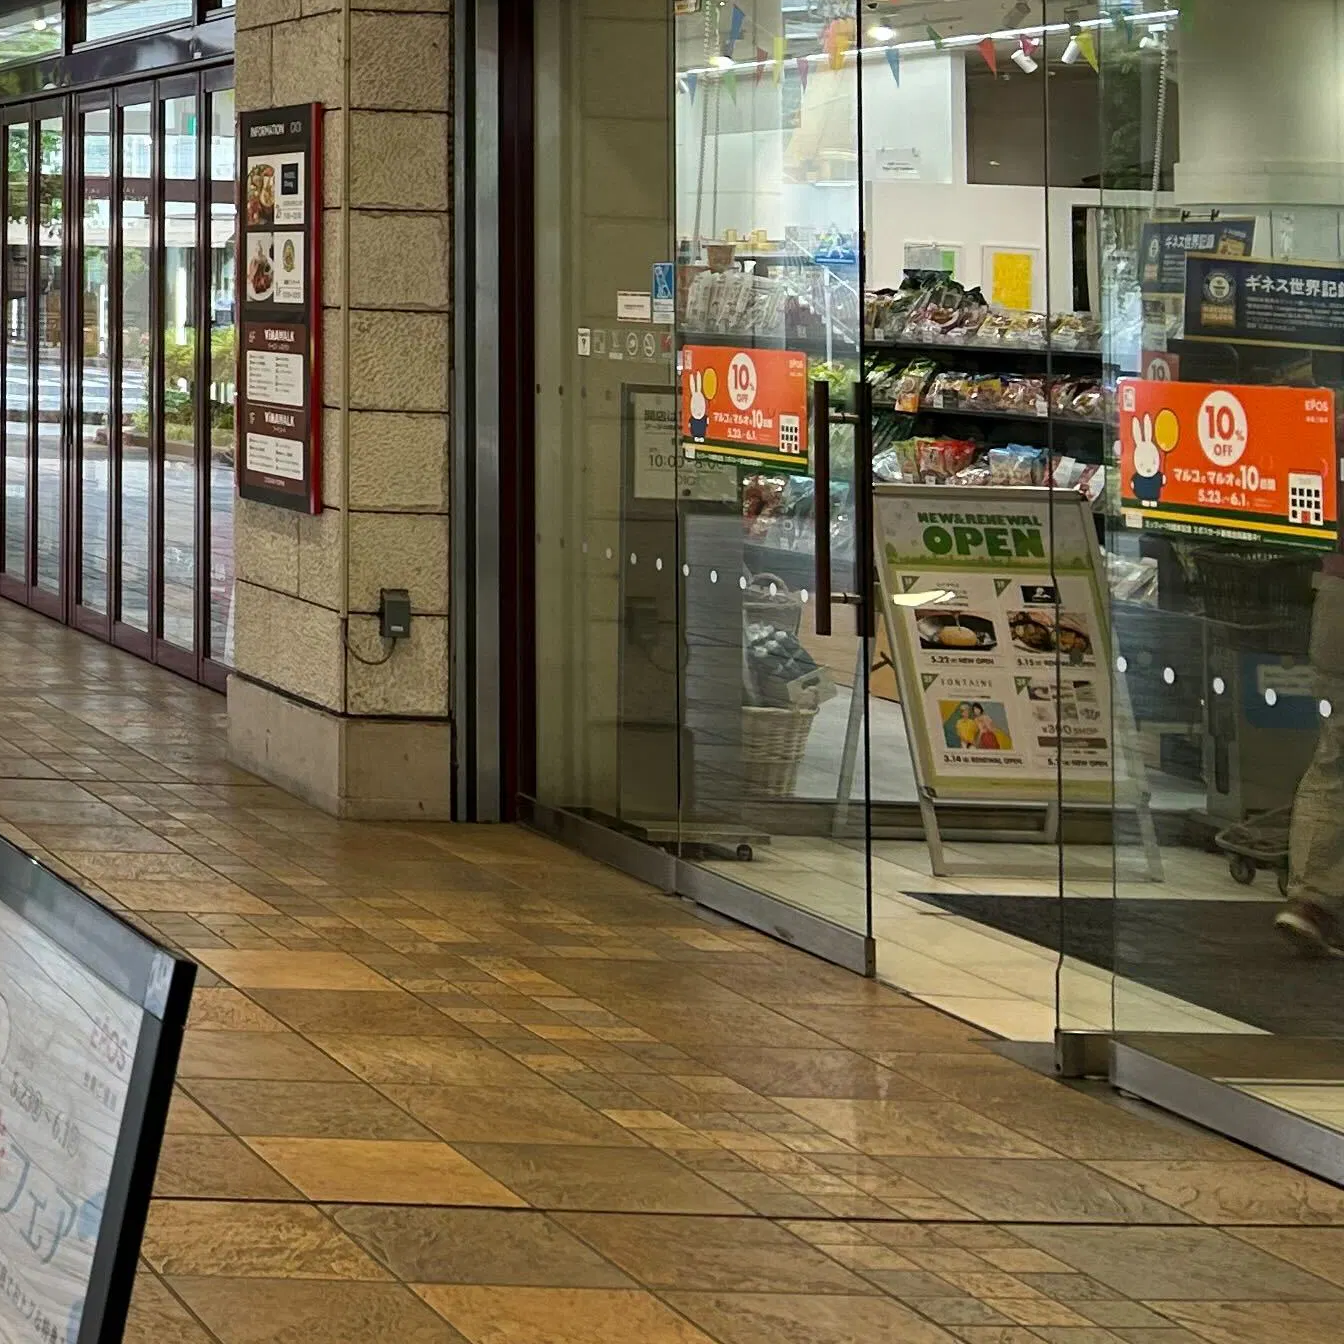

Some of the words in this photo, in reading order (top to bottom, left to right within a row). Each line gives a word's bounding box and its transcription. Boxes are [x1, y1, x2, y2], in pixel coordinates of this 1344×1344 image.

[250, 122, 285, 138] INFORMATION
[1304, 399, 1329, 412] EPOS
[1213, 444, 1233, 457] OFF
[922, 525, 1045, 558] OPEN
